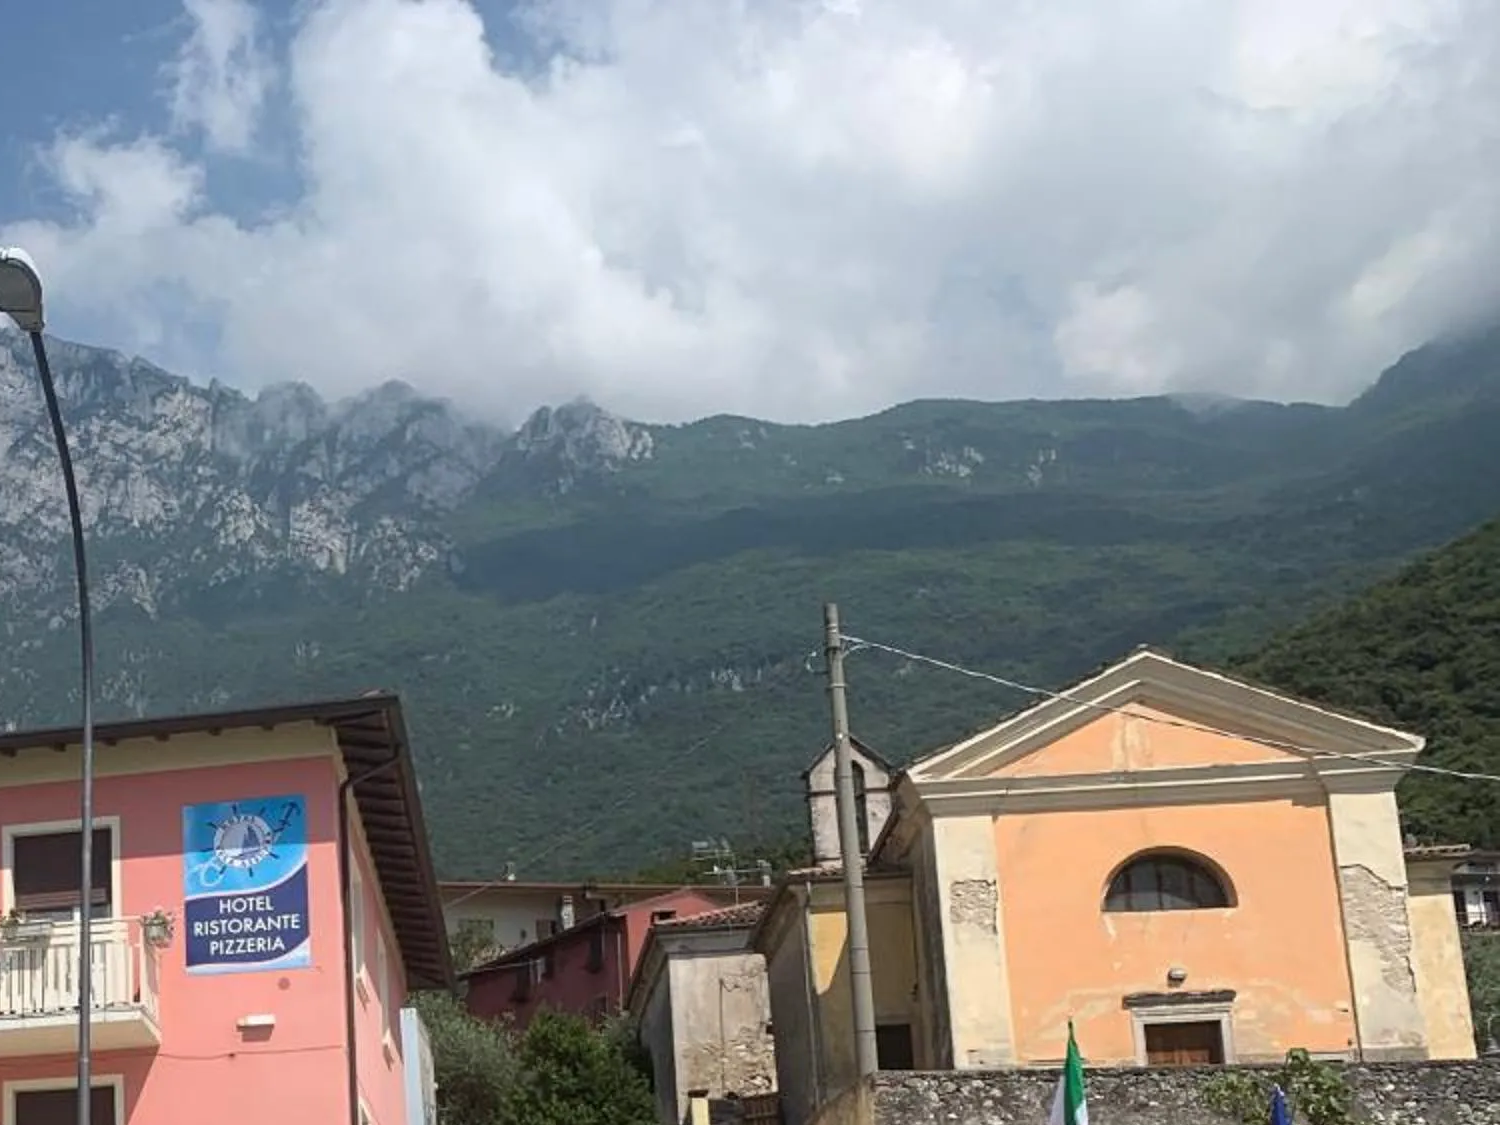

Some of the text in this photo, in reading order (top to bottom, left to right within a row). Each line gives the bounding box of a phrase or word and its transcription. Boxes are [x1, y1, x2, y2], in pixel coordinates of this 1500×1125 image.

[219, 896, 274, 914] HOTEL
[193, 914, 301, 936] RISTORANTE
[209, 939, 286, 956] PIZZERIA
